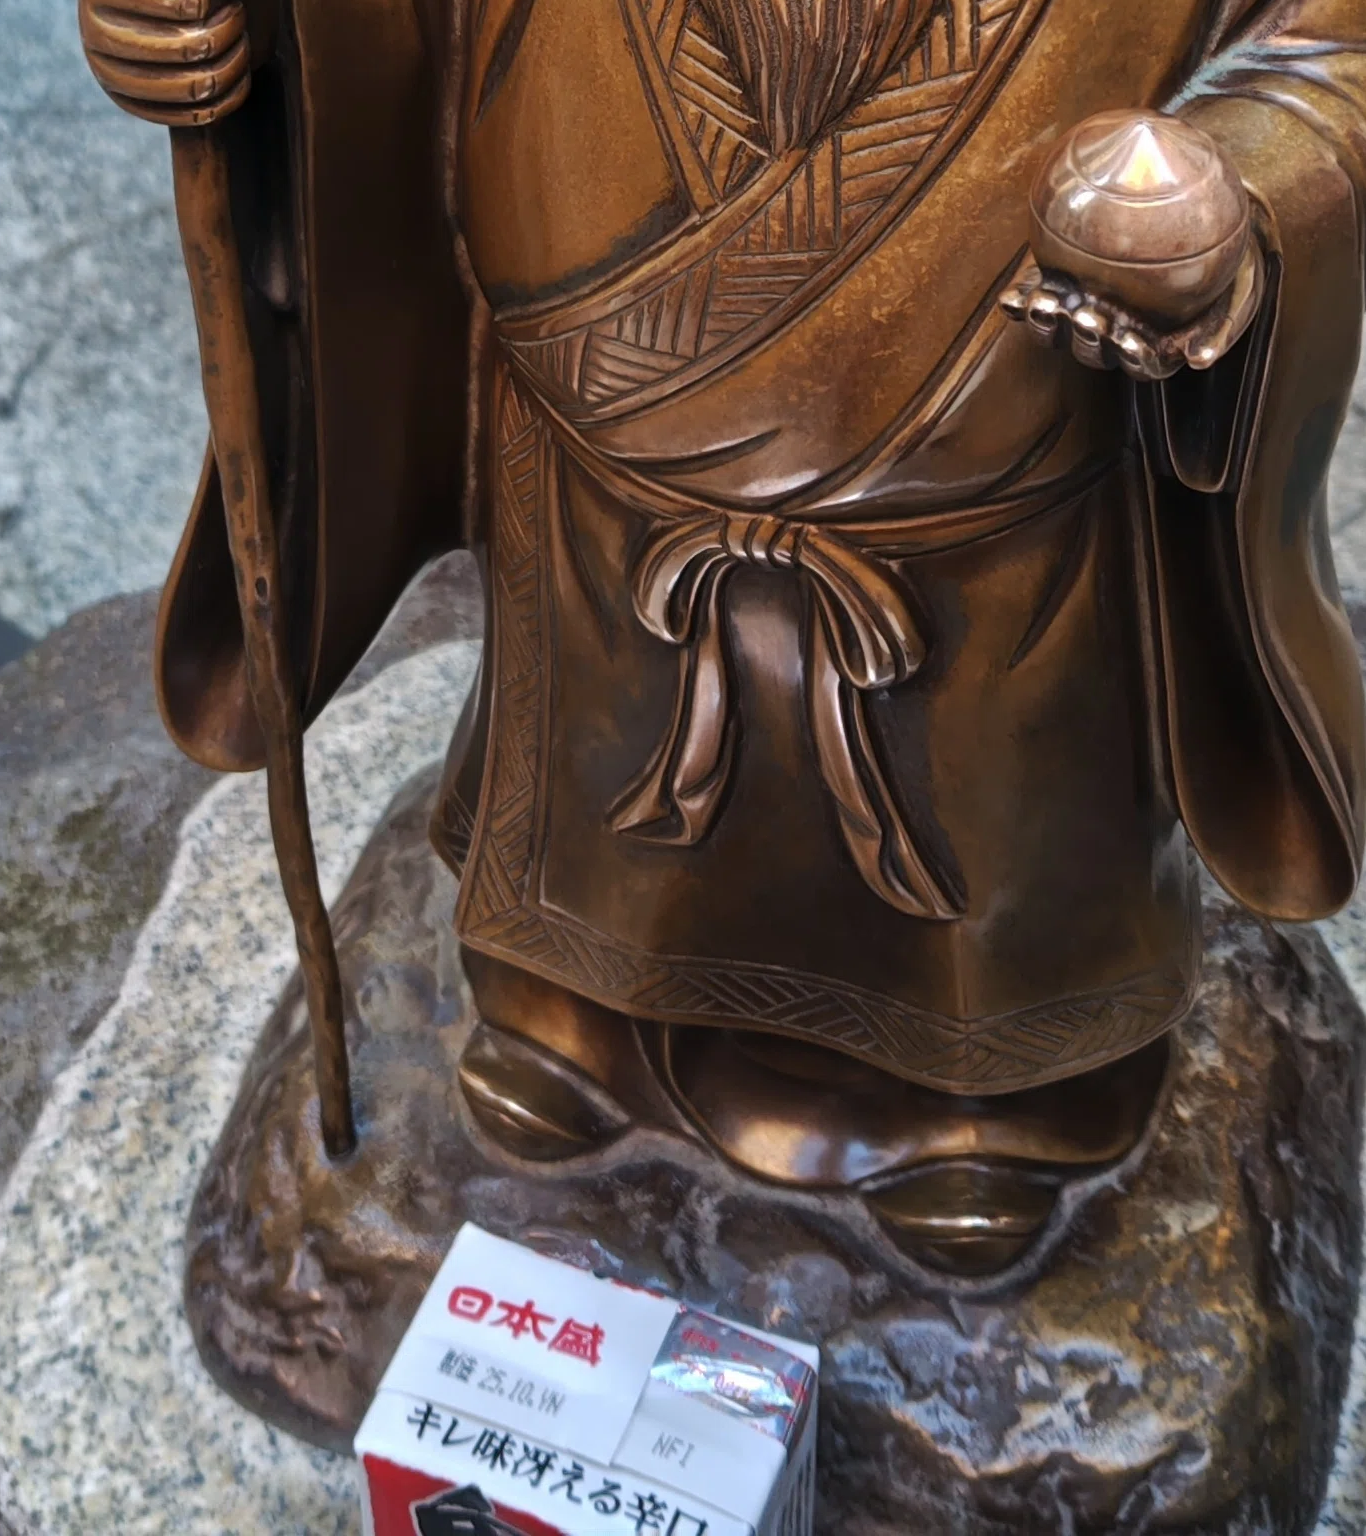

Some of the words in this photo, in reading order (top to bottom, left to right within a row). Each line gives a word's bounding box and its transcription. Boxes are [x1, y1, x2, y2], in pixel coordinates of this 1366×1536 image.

[447, 1285, 606, 1368] 日本盛
[406, 1401, 711, 1535] キレ味冴える辛口
